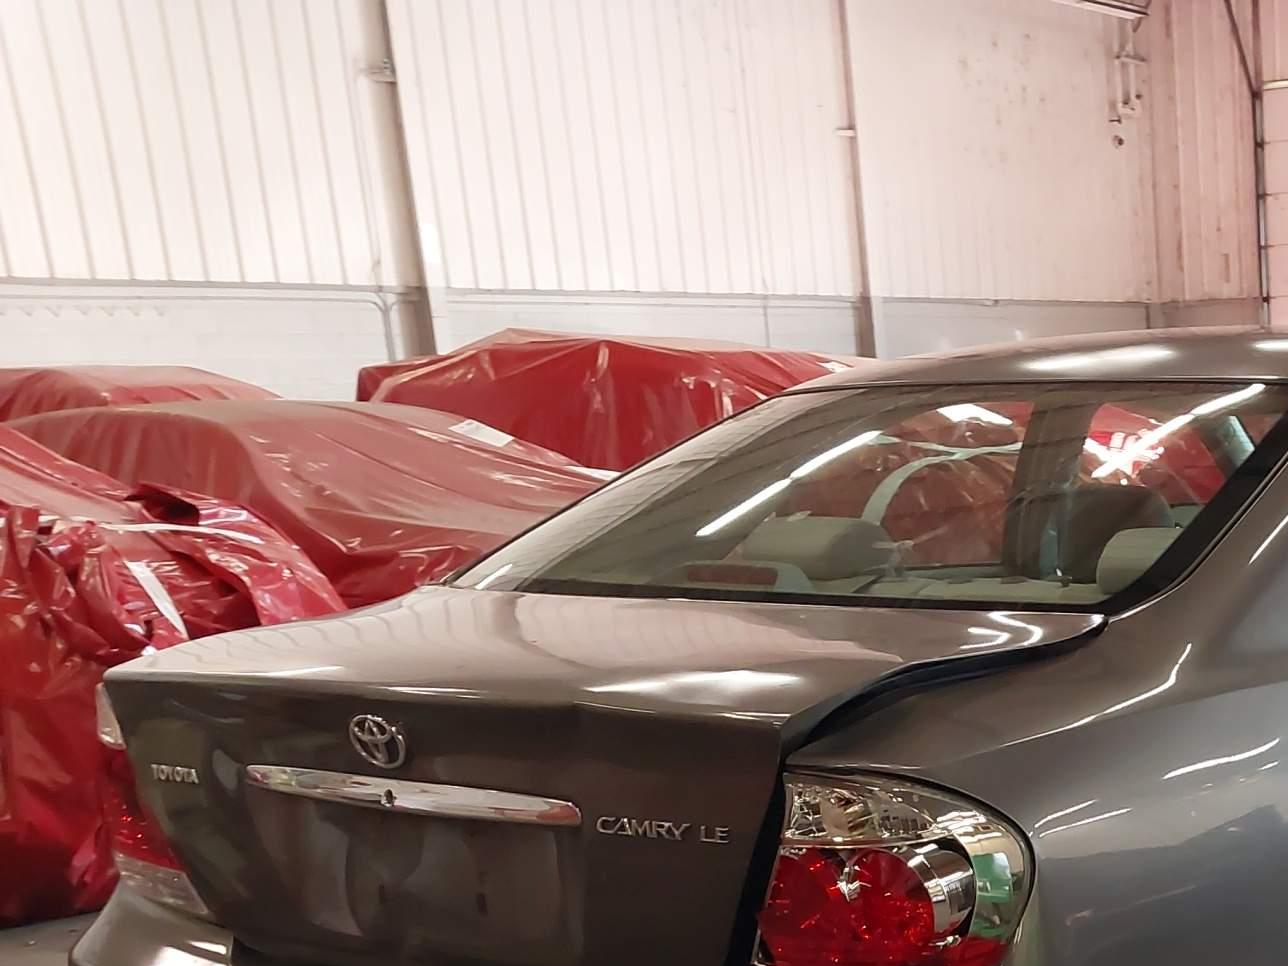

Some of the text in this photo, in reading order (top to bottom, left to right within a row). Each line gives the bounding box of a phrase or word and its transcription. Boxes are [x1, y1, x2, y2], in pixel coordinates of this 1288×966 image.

[151, 763, 199, 784] TOYOTA
[596, 816, 729, 843] CAMRY LE
